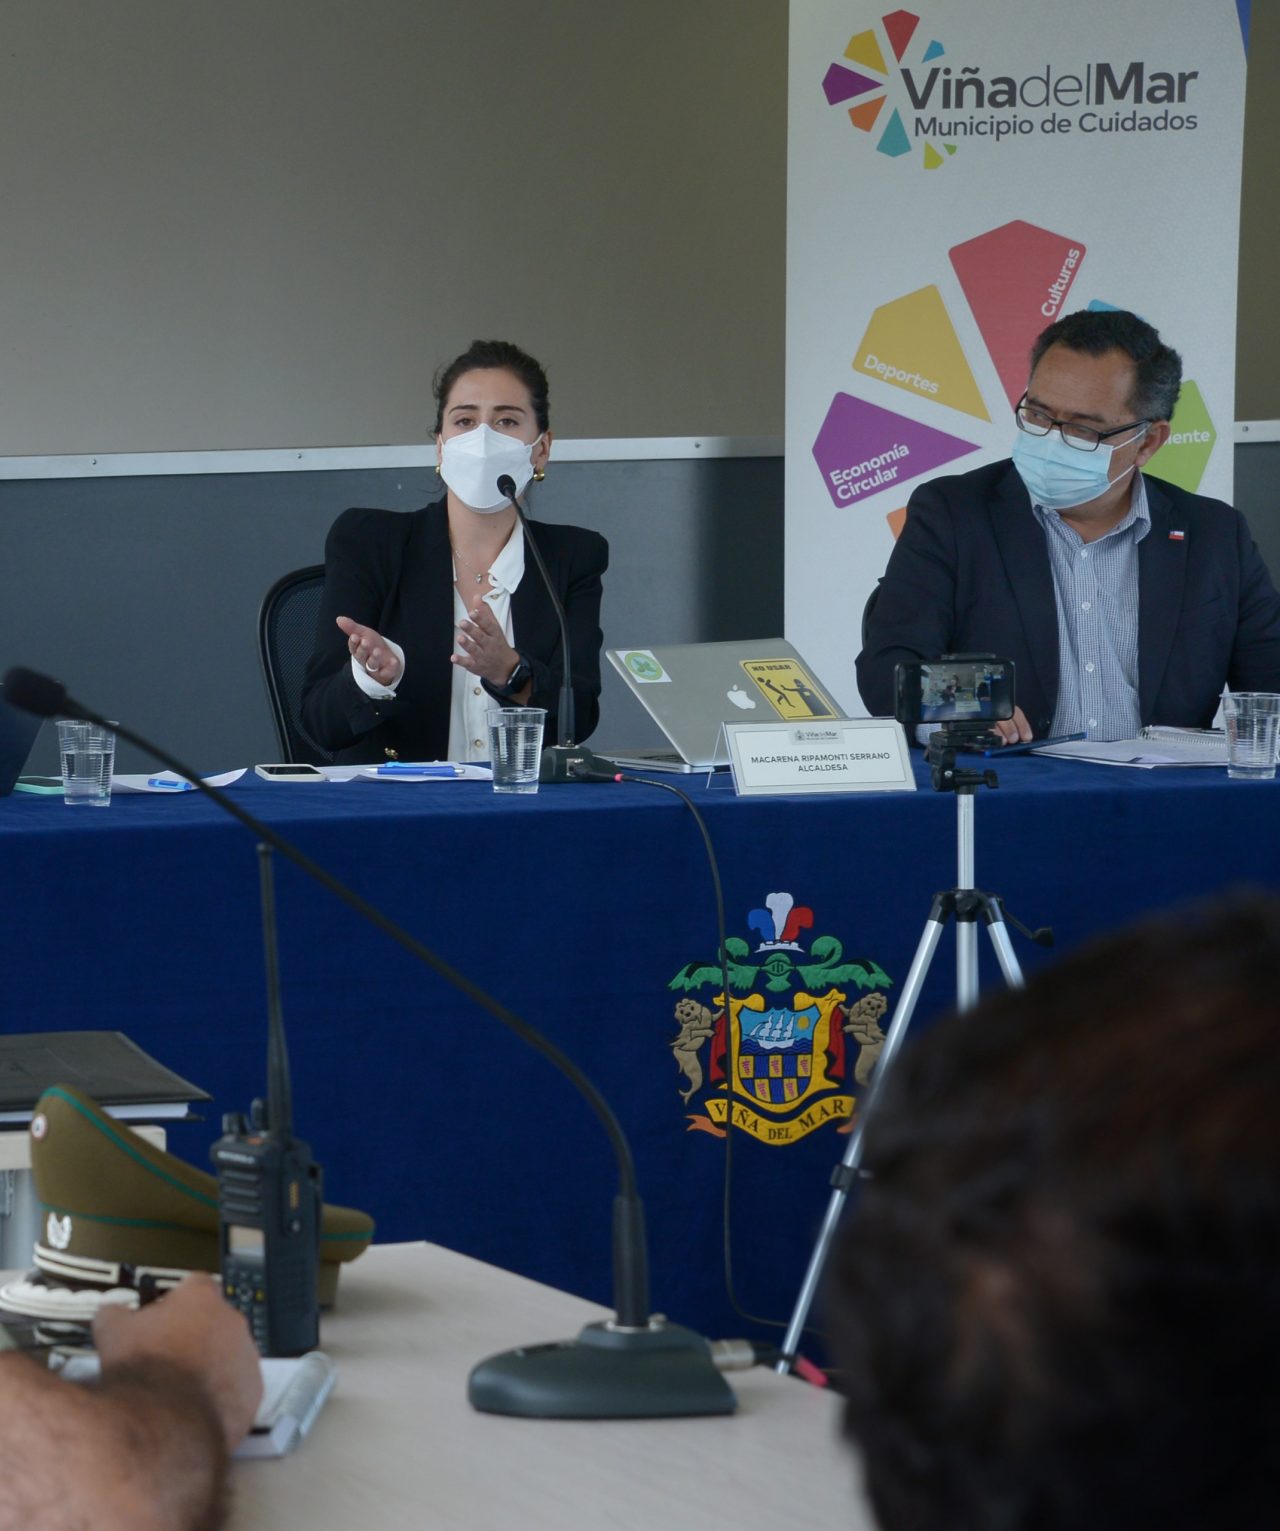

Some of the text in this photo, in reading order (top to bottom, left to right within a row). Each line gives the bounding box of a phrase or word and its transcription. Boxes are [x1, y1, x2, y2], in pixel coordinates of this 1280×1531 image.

[900, 61, 1199, 110] ViñadelMar
[914, 110, 1198, 141] Municipio de Cuidados
[1041, 248, 1080, 317] Culturas
[864, 354, 940, 394] Deportes
[830, 442, 910, 486] Economía
[837, 465, 899, 500] Circular
[751, 752, 890, 763] MACARENA RIPAMONTI SERRANO
[798, 764, 848, 772] ALCALDESA
[714, 1099, 845, 1140] VÑA DEL MAR
